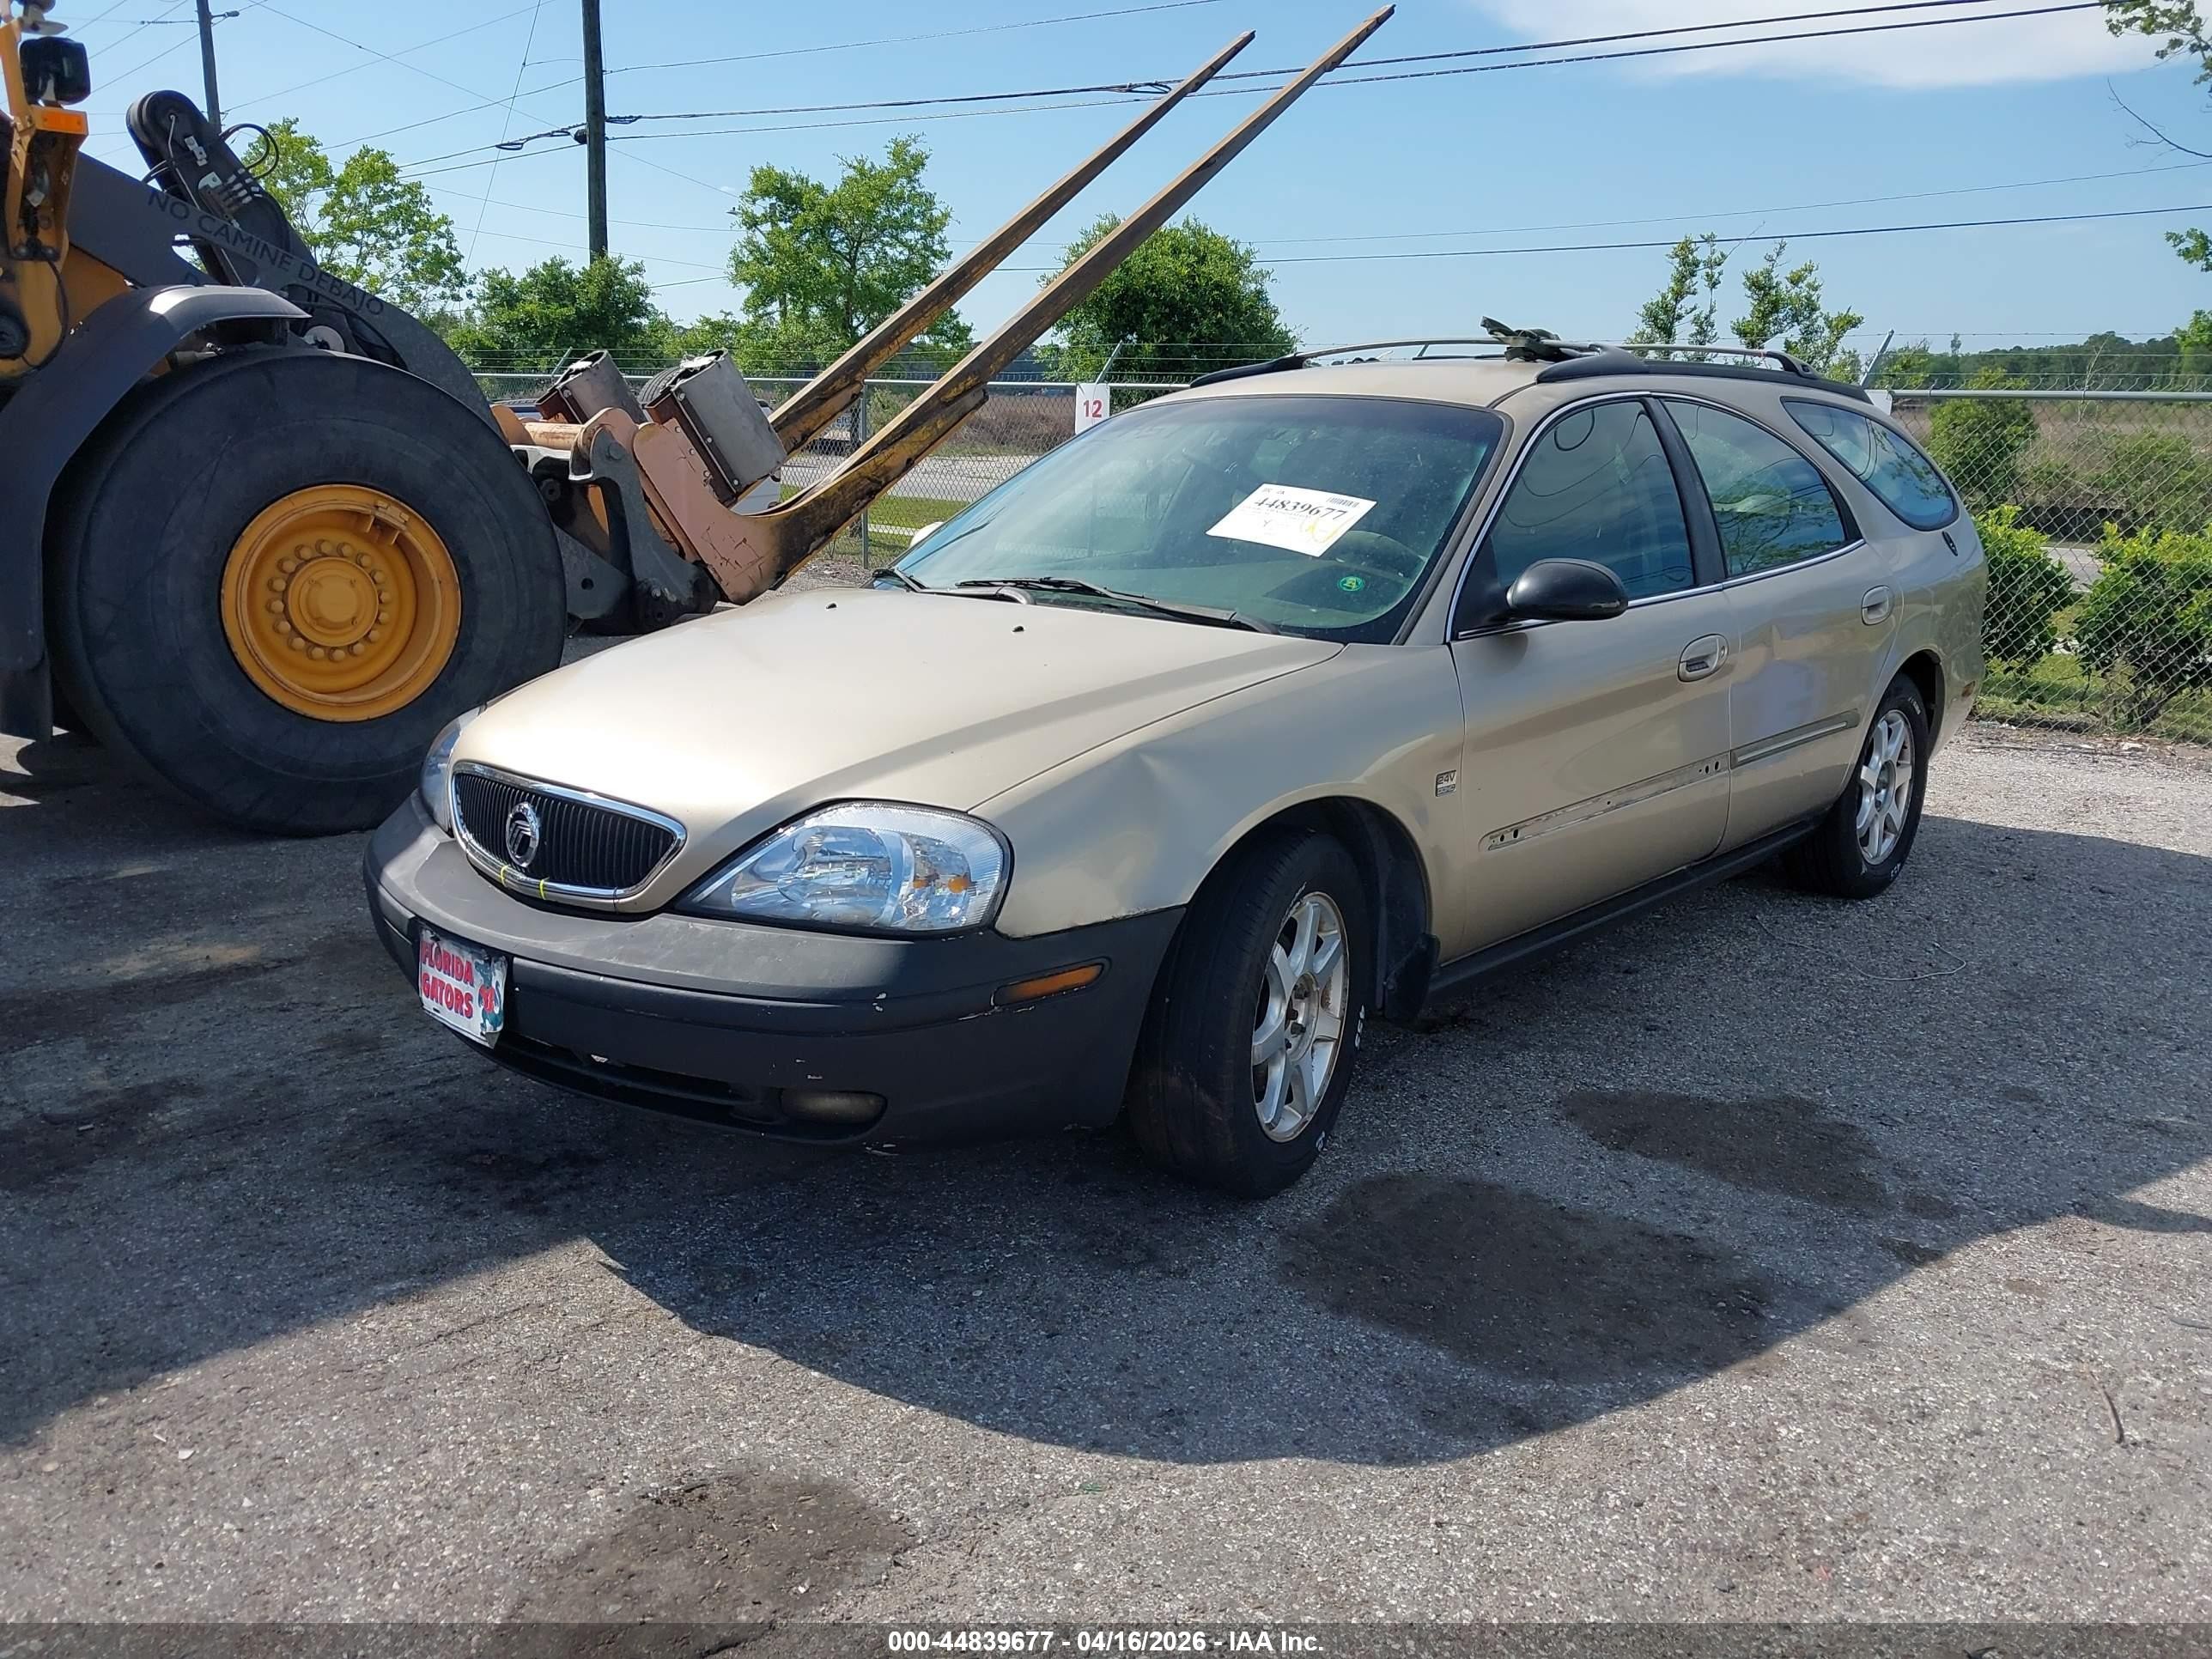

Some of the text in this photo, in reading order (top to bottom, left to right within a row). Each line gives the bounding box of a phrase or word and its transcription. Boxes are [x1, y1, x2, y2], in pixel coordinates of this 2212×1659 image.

[148, 192, 385, 316] NO CAMINE DEBAJO
[1083, 399, 1103, 418] 12
[1254, 496, 1349, 520] 44839677
[422, 939, 475, 988] FLORIDA
[422, 971, 474, 1019] GATORS
